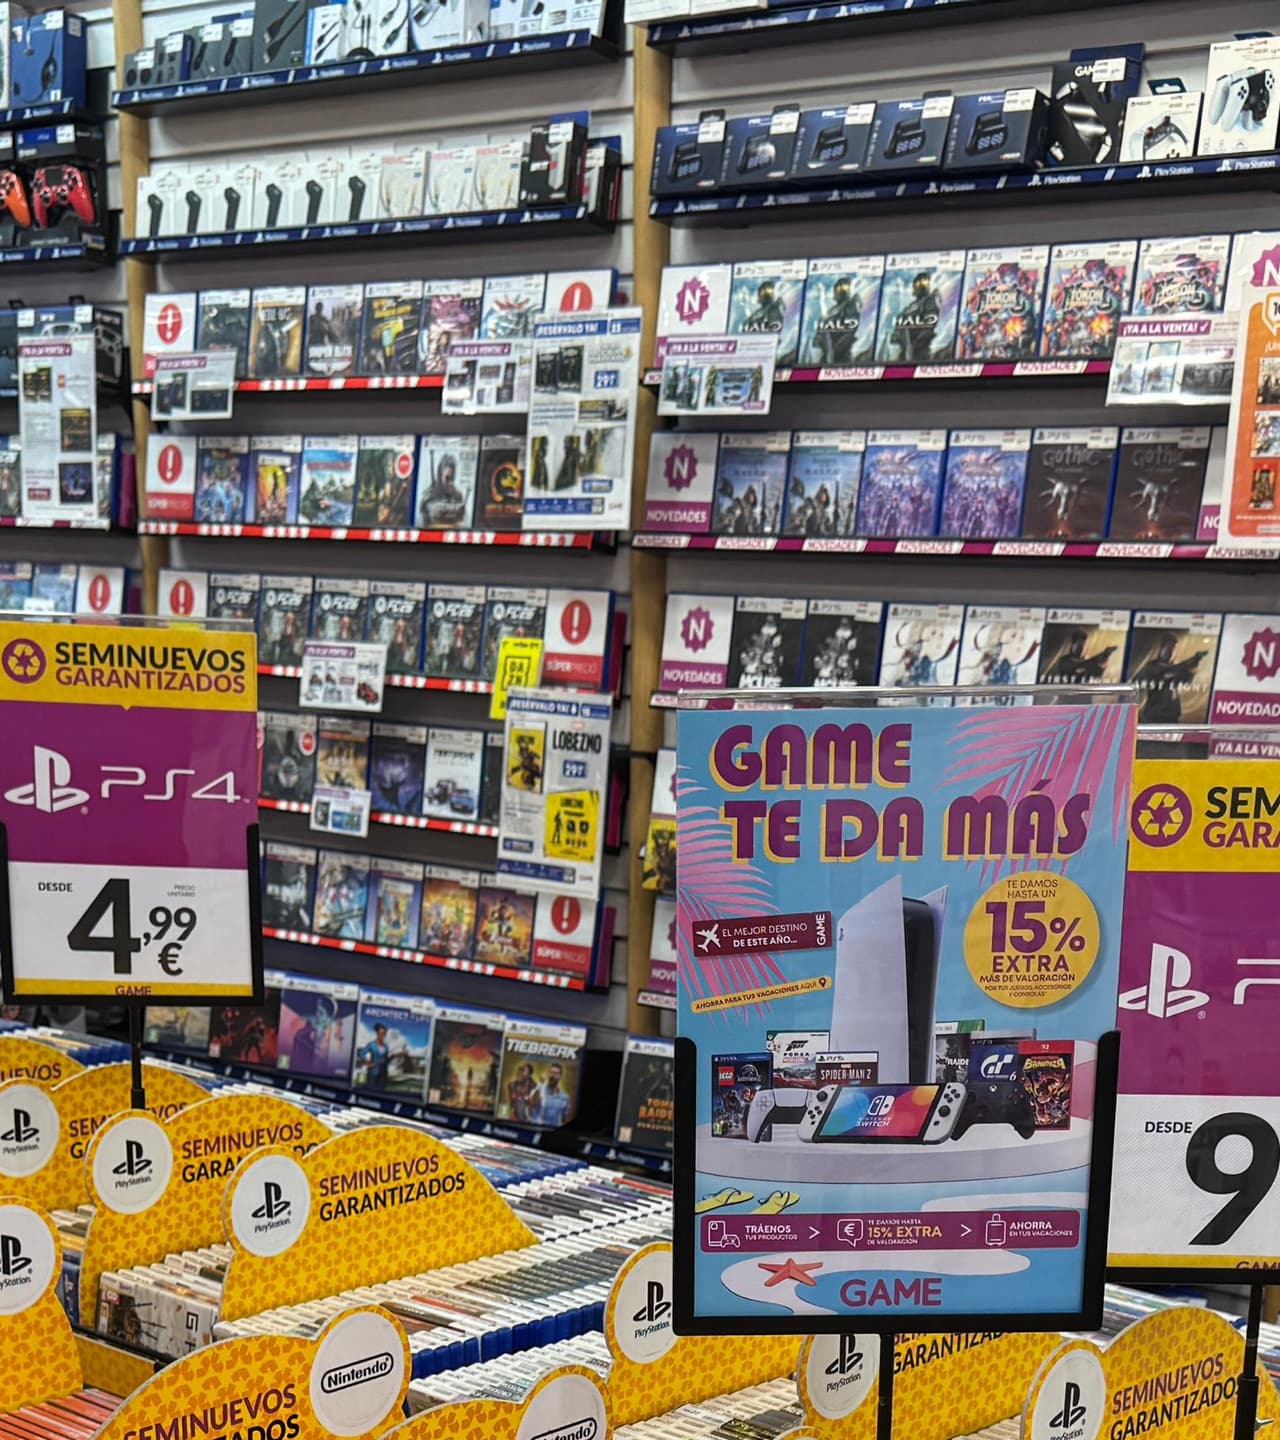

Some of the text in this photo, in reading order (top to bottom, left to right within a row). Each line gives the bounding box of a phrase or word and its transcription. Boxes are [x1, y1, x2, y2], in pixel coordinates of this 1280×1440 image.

[647, 509, 706, 524] NOVEDADES
[55, 642, 245, 673] SEMINUEVOS
[56, 667, 245, 693] GARANTIZADOS
[553, 730, 602, 754] LOBEZNO
[711, 723, 912, 791] GAME
[101, 766, 241, 803] PS4
[721, 780, 1090, 862] TE DA MÁS
[38, 882, 73, 892] DESDE
[1007, 879, 1058, 888] TE DAMOS
[1007, 889, 1056, 899] HASTA UN
[723, 922, 807, 937] EL MEJOR DESTINO
[816, 914, 826, 946] GAME
[985, 901, 1085, 953] 15%
[733, 938, 746, 947] DE
[748, 937, 767, 947] ESTE
[993, 955, 1068, 973] EXTRA
[979, 972, 1075, 983] MÁS DE VALORACIÓN
[115, 986, 151, 996] GAME
[506, 1039, 578, 1060] TIEBREAK
[1145, 1121, 1192, 1134] DESDE
[745, 1224, 792, 1234] TRÁENOS
[868, 1226, 941, 1238] 15% EXTRA
[1010, 1221, 1052, 1231] AHORRA
[840, 1279, 942, 1306] GAME
[325, 1355, 389, 1388] Nintendo
